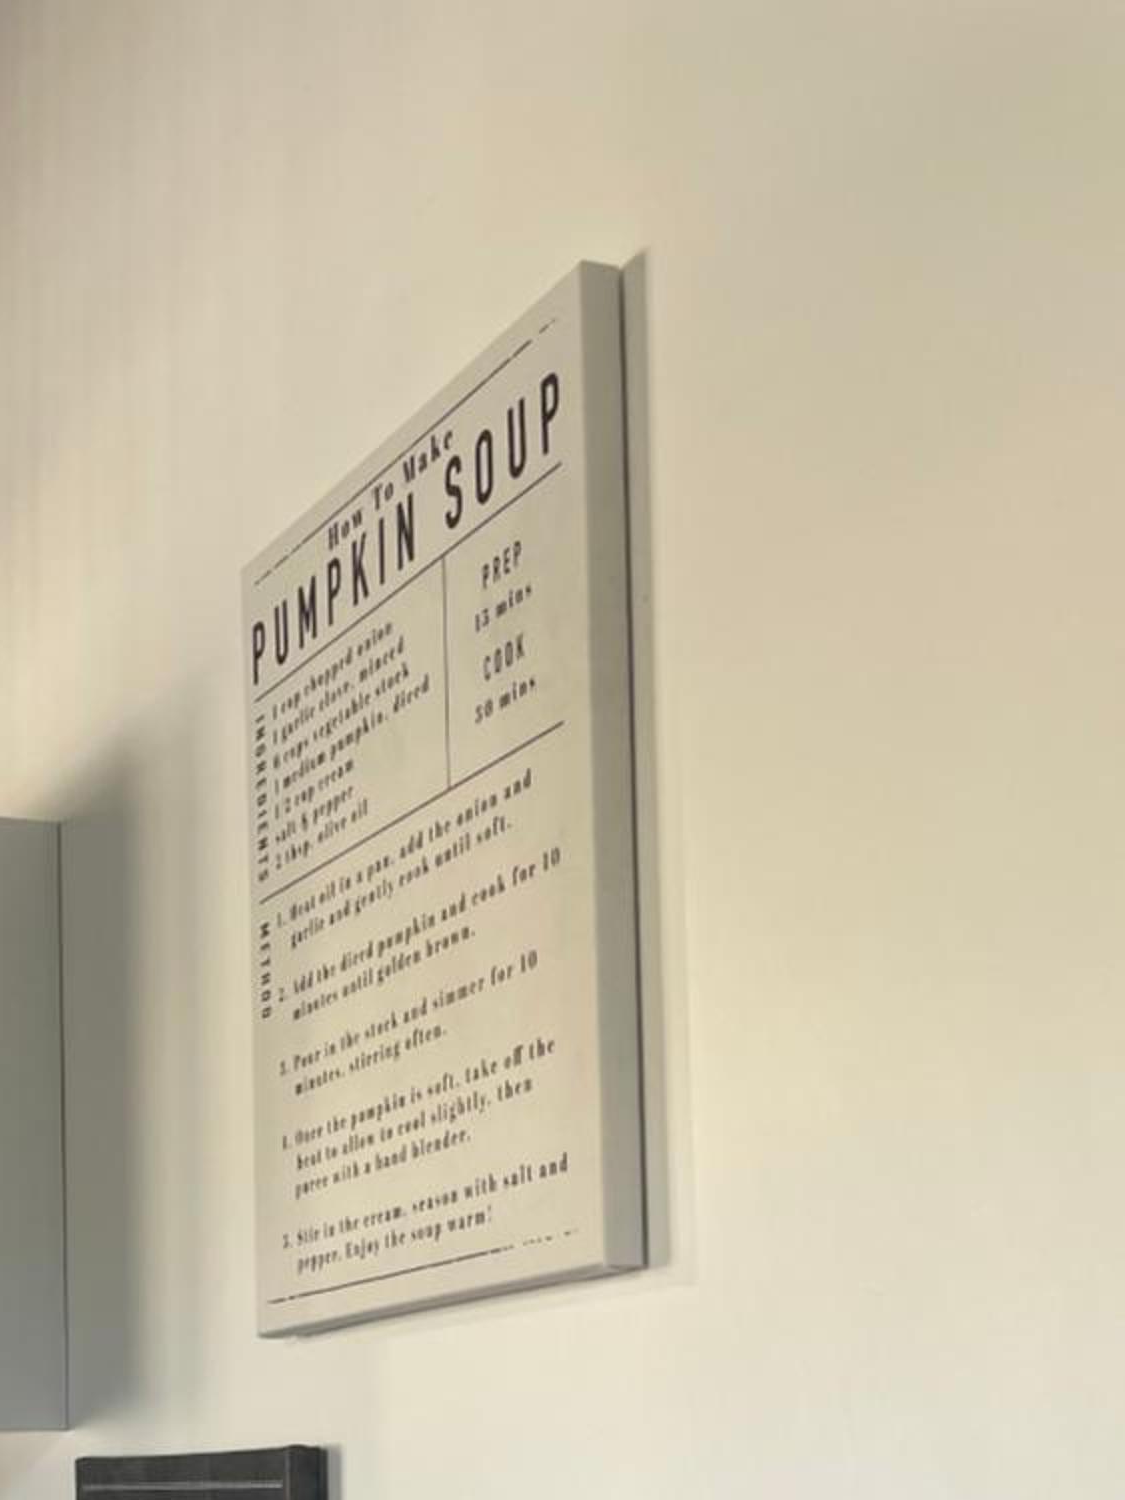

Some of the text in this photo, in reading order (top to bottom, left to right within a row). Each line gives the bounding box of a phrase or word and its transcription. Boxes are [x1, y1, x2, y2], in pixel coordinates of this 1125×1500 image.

[253, 373, 559, 685] PUMPKIN SOUP
[372, 482, 394, 511] To
[482, 541, 521, 589] PREP
[496, 585, 531, 618] mins
[281, 691, 300, 714] cup
[304, 646, 353, 696] chopped
[483, 633, 524, 681] COOK
[499, 678, 535, 709] mins
[283, 751, 326, 789] medium
[393, 674, 429, 714] diced
[313, 692, 371, 742] vegetable
[375, 662, 409, 697] stock
[313, 786, 353, 825] pepper
[319, 880, 336, 904] oil
[400, 831, 423, 859] add
[429, 821, 451, 842] the
[456, 794, 497, 826] onion
[504, 768, 531, 800] and
[351, 798, 368, 823] oil
[291, 816, 511, 950] garlic and gently cook until soft.
[294, 971, 313, 994] Add
[317, 964, 336, 983] the
[340, 940, 373, 972] diced
[377, 914, 435, 958] pumpkin
[441, 893, 466, 921] and
[472, 874, 506, 906] cook
[512, 864, 536, 886] for
[543, 847, 560, 871] 10
[293, 926, 475, 1020] minutes until golden brown.
[294, 1050, 321, 1071] Pour
[340, 1031, 360, 1051] the
[365, 1011, 398, 1039] stock
[403, 997, 427, 1024] and
[432, 978, 485, 1009] simmer
[491, 965, 513, 986] for
[521, 950, 537, 973] 10
[295, 1126, 323, 1145] Once
[327, 1116, 347, 1134] the
[351, 1094, 405, 1131] pumpkin
[465, 1059, 497, 1084] take
[504, 1045, 523, 1069] off
[529, 1038, 555, 1060] the
[349, 1040, 400, 1072] stirring
[297, 1149, 321, 1171] heat
[342, 1134, 375, 1155] allow
[397, 1110, 425, 1136] cool
[497, 1079, 532, 1101] then
[295, 1176, 328, 1200] puree
[333, 1161, 360, 1184] with
[375, 1144, 407, 1171] hand
[339, 1216, 359, 1233] the
[413, 1190, 457, 1212] season
[464, 1173, 497, 1199] with
[503, 1164, 532, 1189] salt
[539, 1152, 567, 1178] and
[345, 1238, 379, 1260] Enjoy
[385, 1230, 405, 1248] the
[411, 1223, 442, 1242] soup
